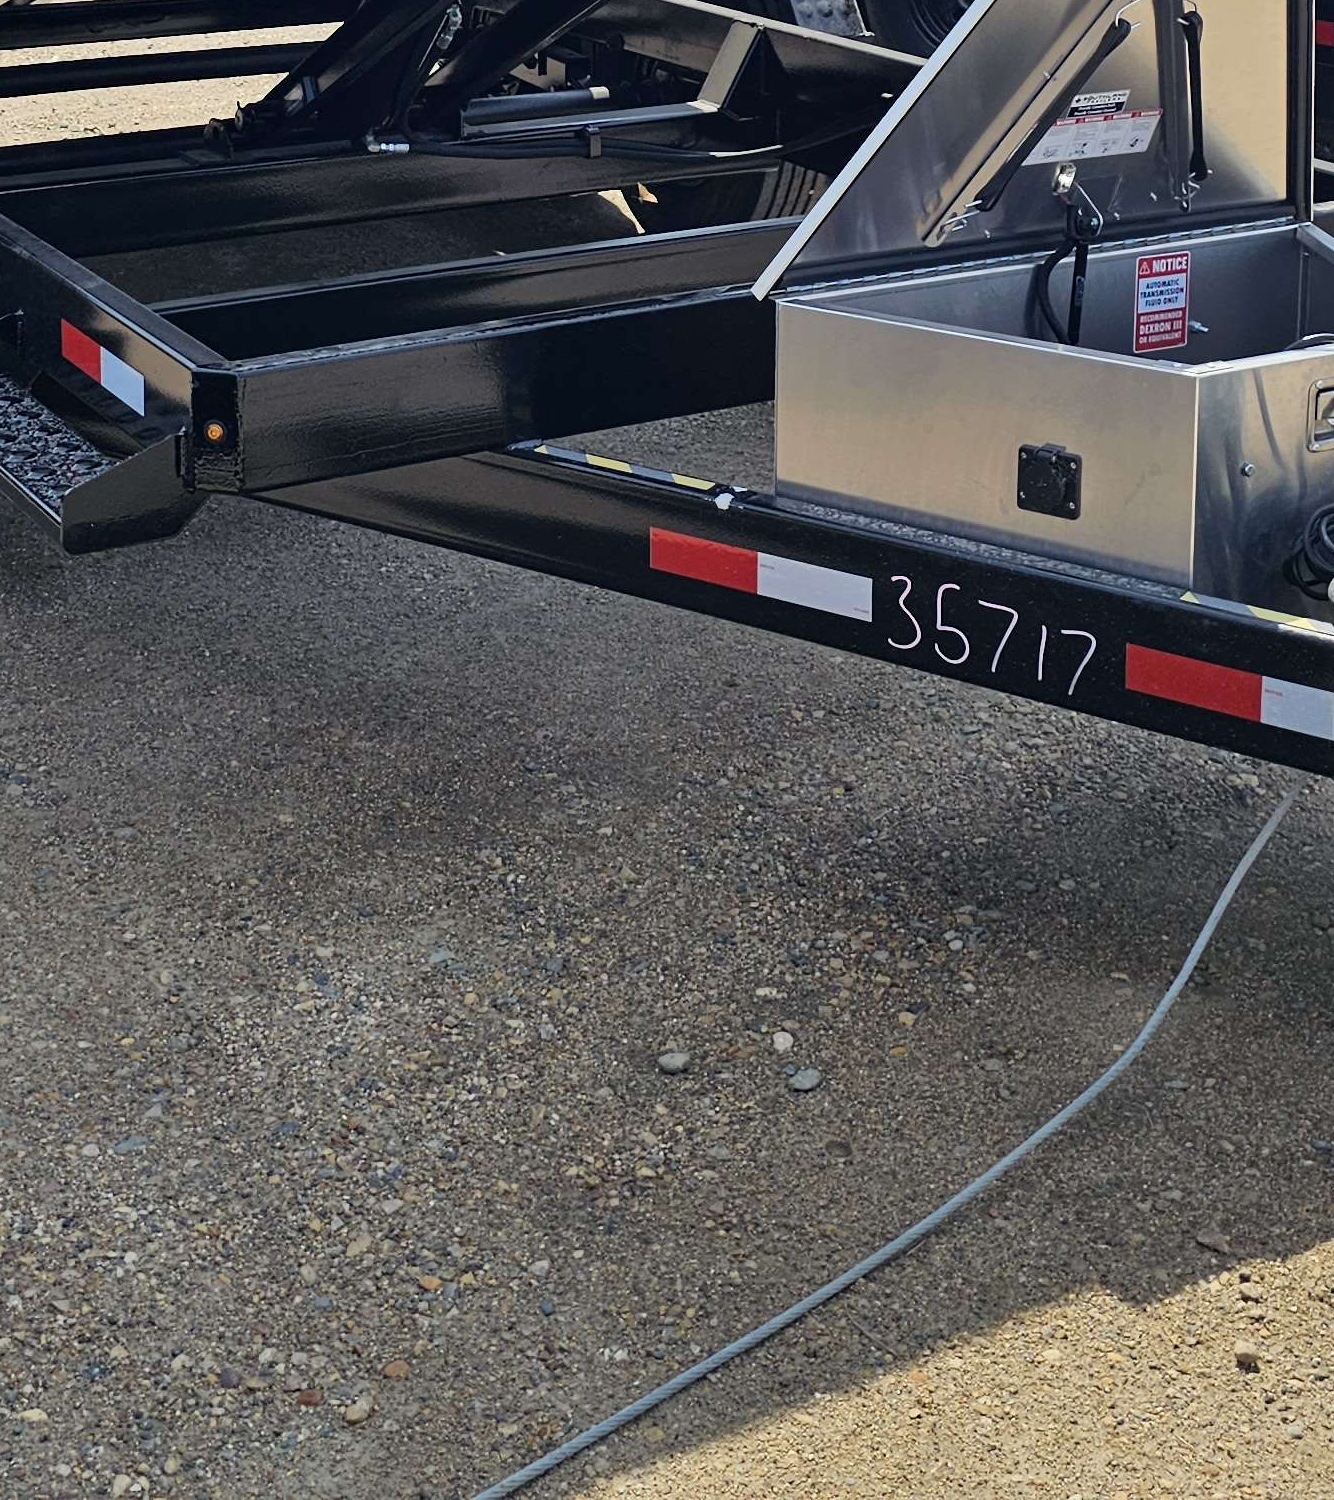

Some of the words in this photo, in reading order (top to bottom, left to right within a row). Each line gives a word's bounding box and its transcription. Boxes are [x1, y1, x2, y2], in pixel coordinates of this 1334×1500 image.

[1152, 257, 1187, 273] NOTICE
[1146, 279, 1179, 289] AUTOMATIC
[1140, 287, 1184, 298] TRANSMISSION
[1145, 298, 1161, 307] FLUID
[1163, 296, 1178, 305] ONLY
[1139, 321, 1171, 335] DEXRON
[887, 575, 1097, 696] 35717
